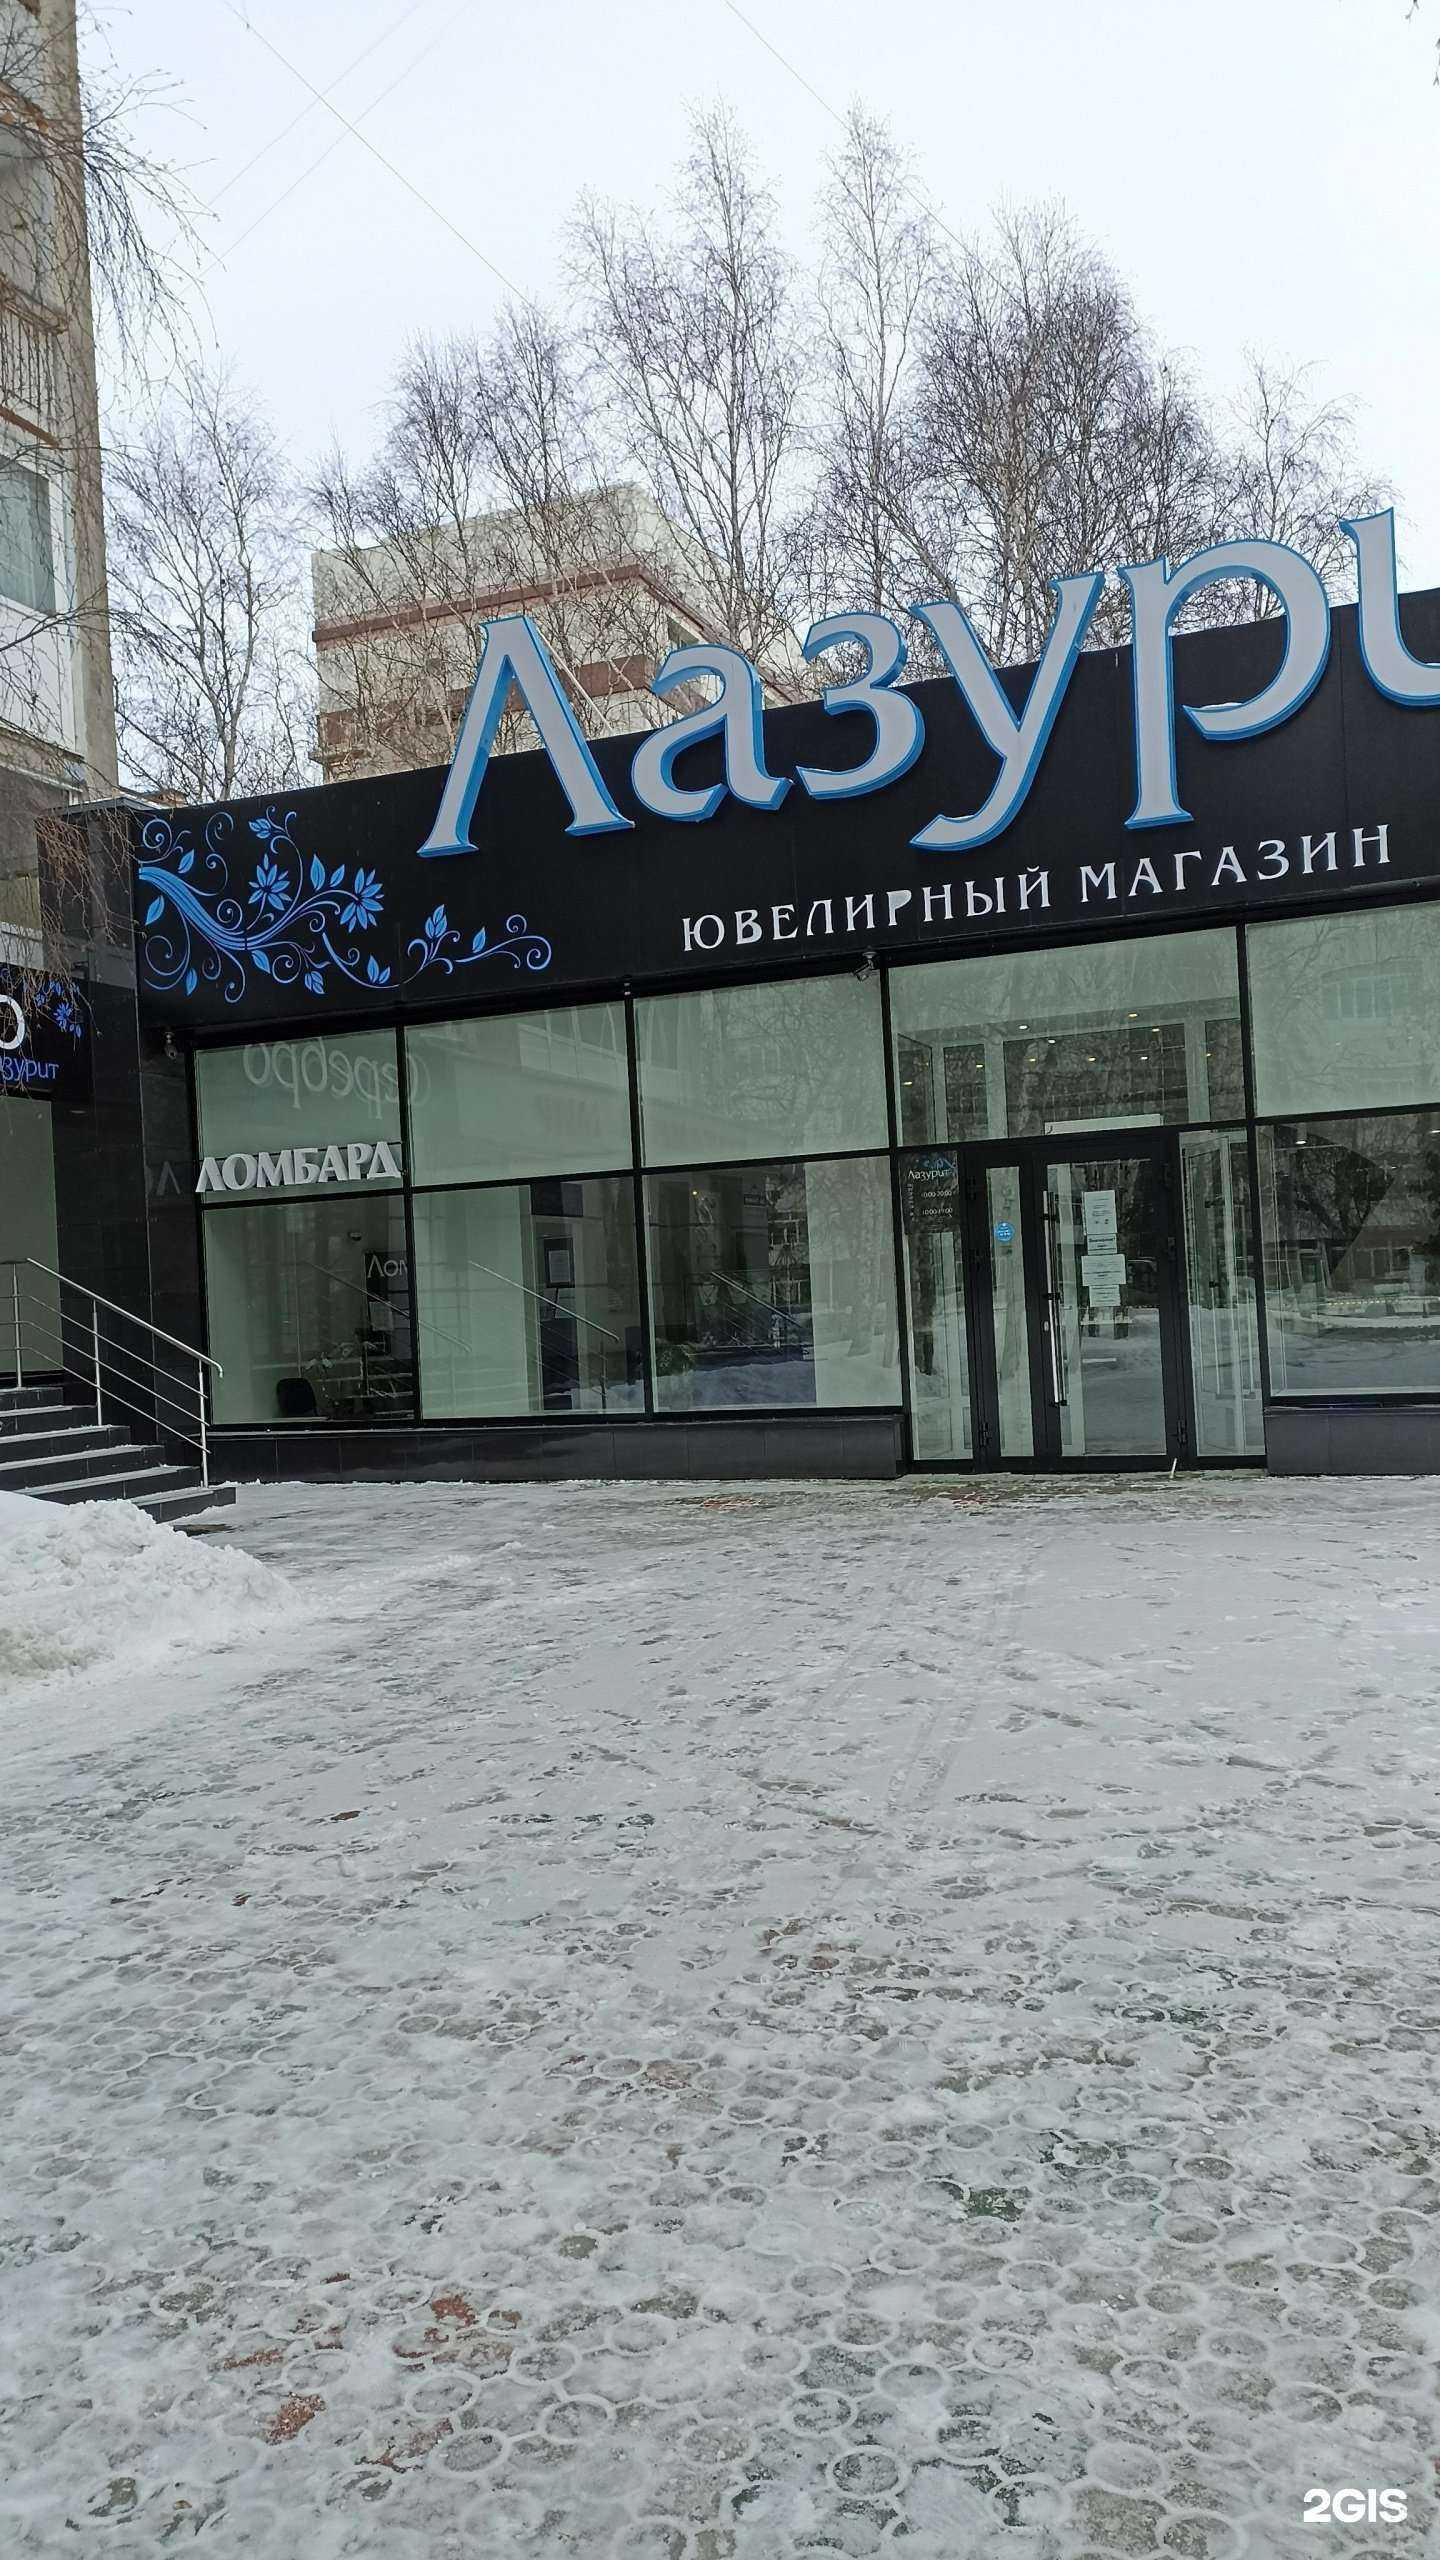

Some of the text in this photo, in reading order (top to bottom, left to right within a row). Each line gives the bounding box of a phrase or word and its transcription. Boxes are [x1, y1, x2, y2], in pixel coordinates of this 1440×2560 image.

[682, 822, 1393, 953] ЮВЕЛИРНЫЙ МАГАЗИН
[0, 1056, 60, 1083] зурит
[195, 1141, 402, 1193] ЛОМБАРД
